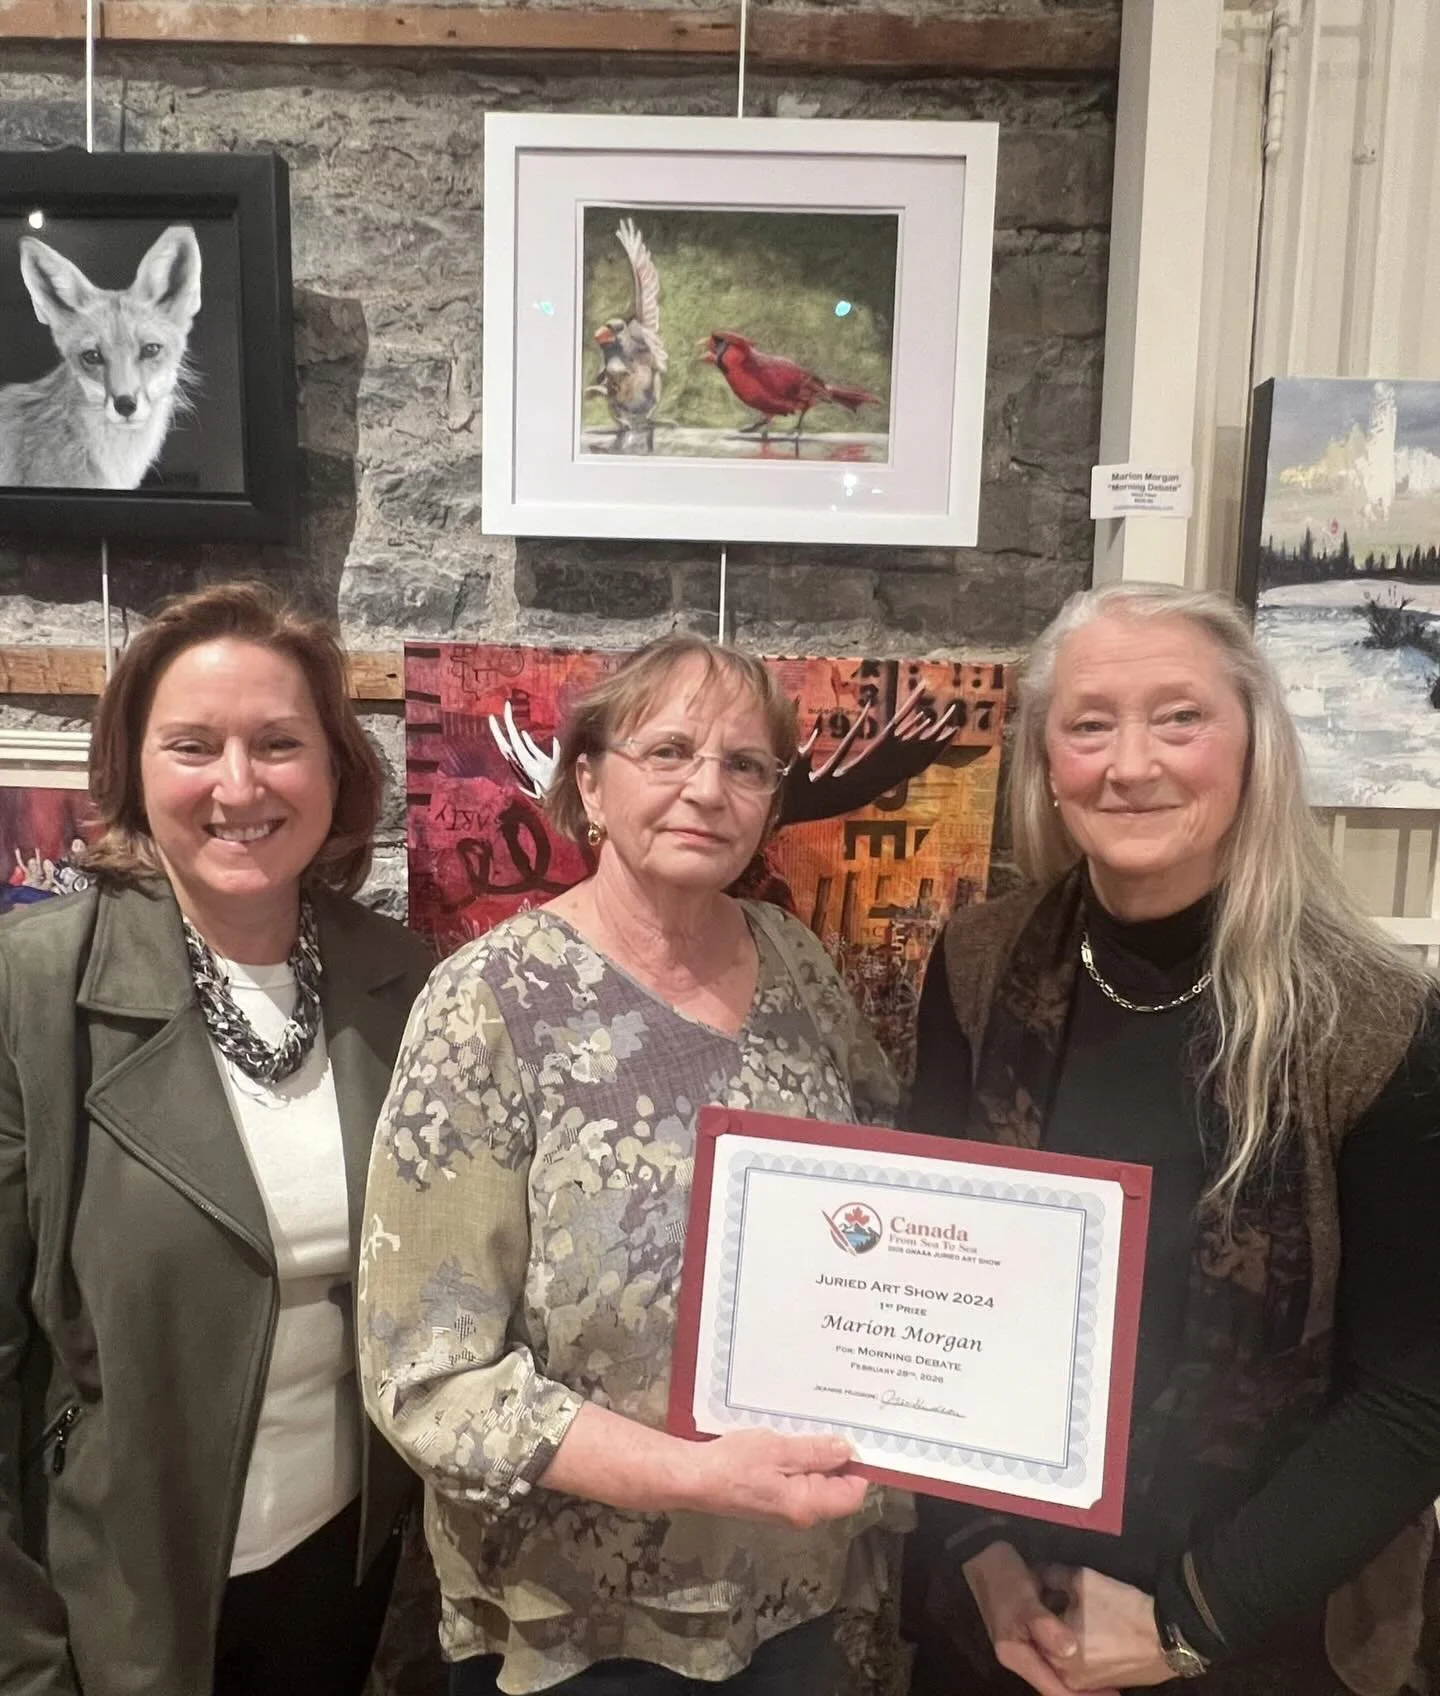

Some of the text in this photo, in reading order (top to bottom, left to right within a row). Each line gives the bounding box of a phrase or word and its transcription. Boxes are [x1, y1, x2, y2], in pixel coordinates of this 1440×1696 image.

[1111, 473, 1180, 482] Marion Morgan
[890, 1216, 969, 1243] Canada
[889, 1233, 978, 1254] From Sea To Sea
[952, 1292, 995, 1308] 2024
[821, 1314, 983, 1352] Marion Morgan
